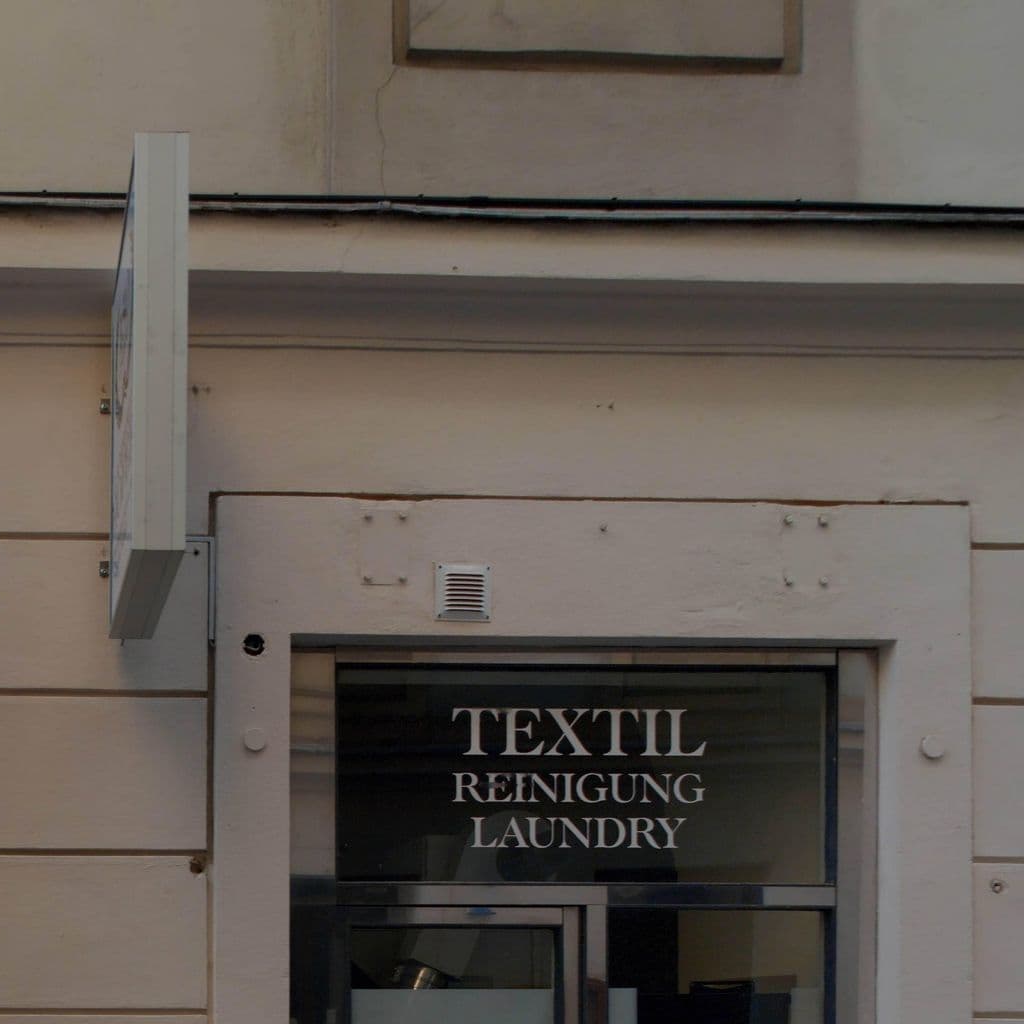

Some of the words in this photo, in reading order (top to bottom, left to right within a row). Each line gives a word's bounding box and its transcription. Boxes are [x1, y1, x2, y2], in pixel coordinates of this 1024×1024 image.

[452, 708, 707, 757] TEXTIL
[452, 772, 706, 804] REINIGUNG
[470, 816, 687, 849] LAUNDRY
